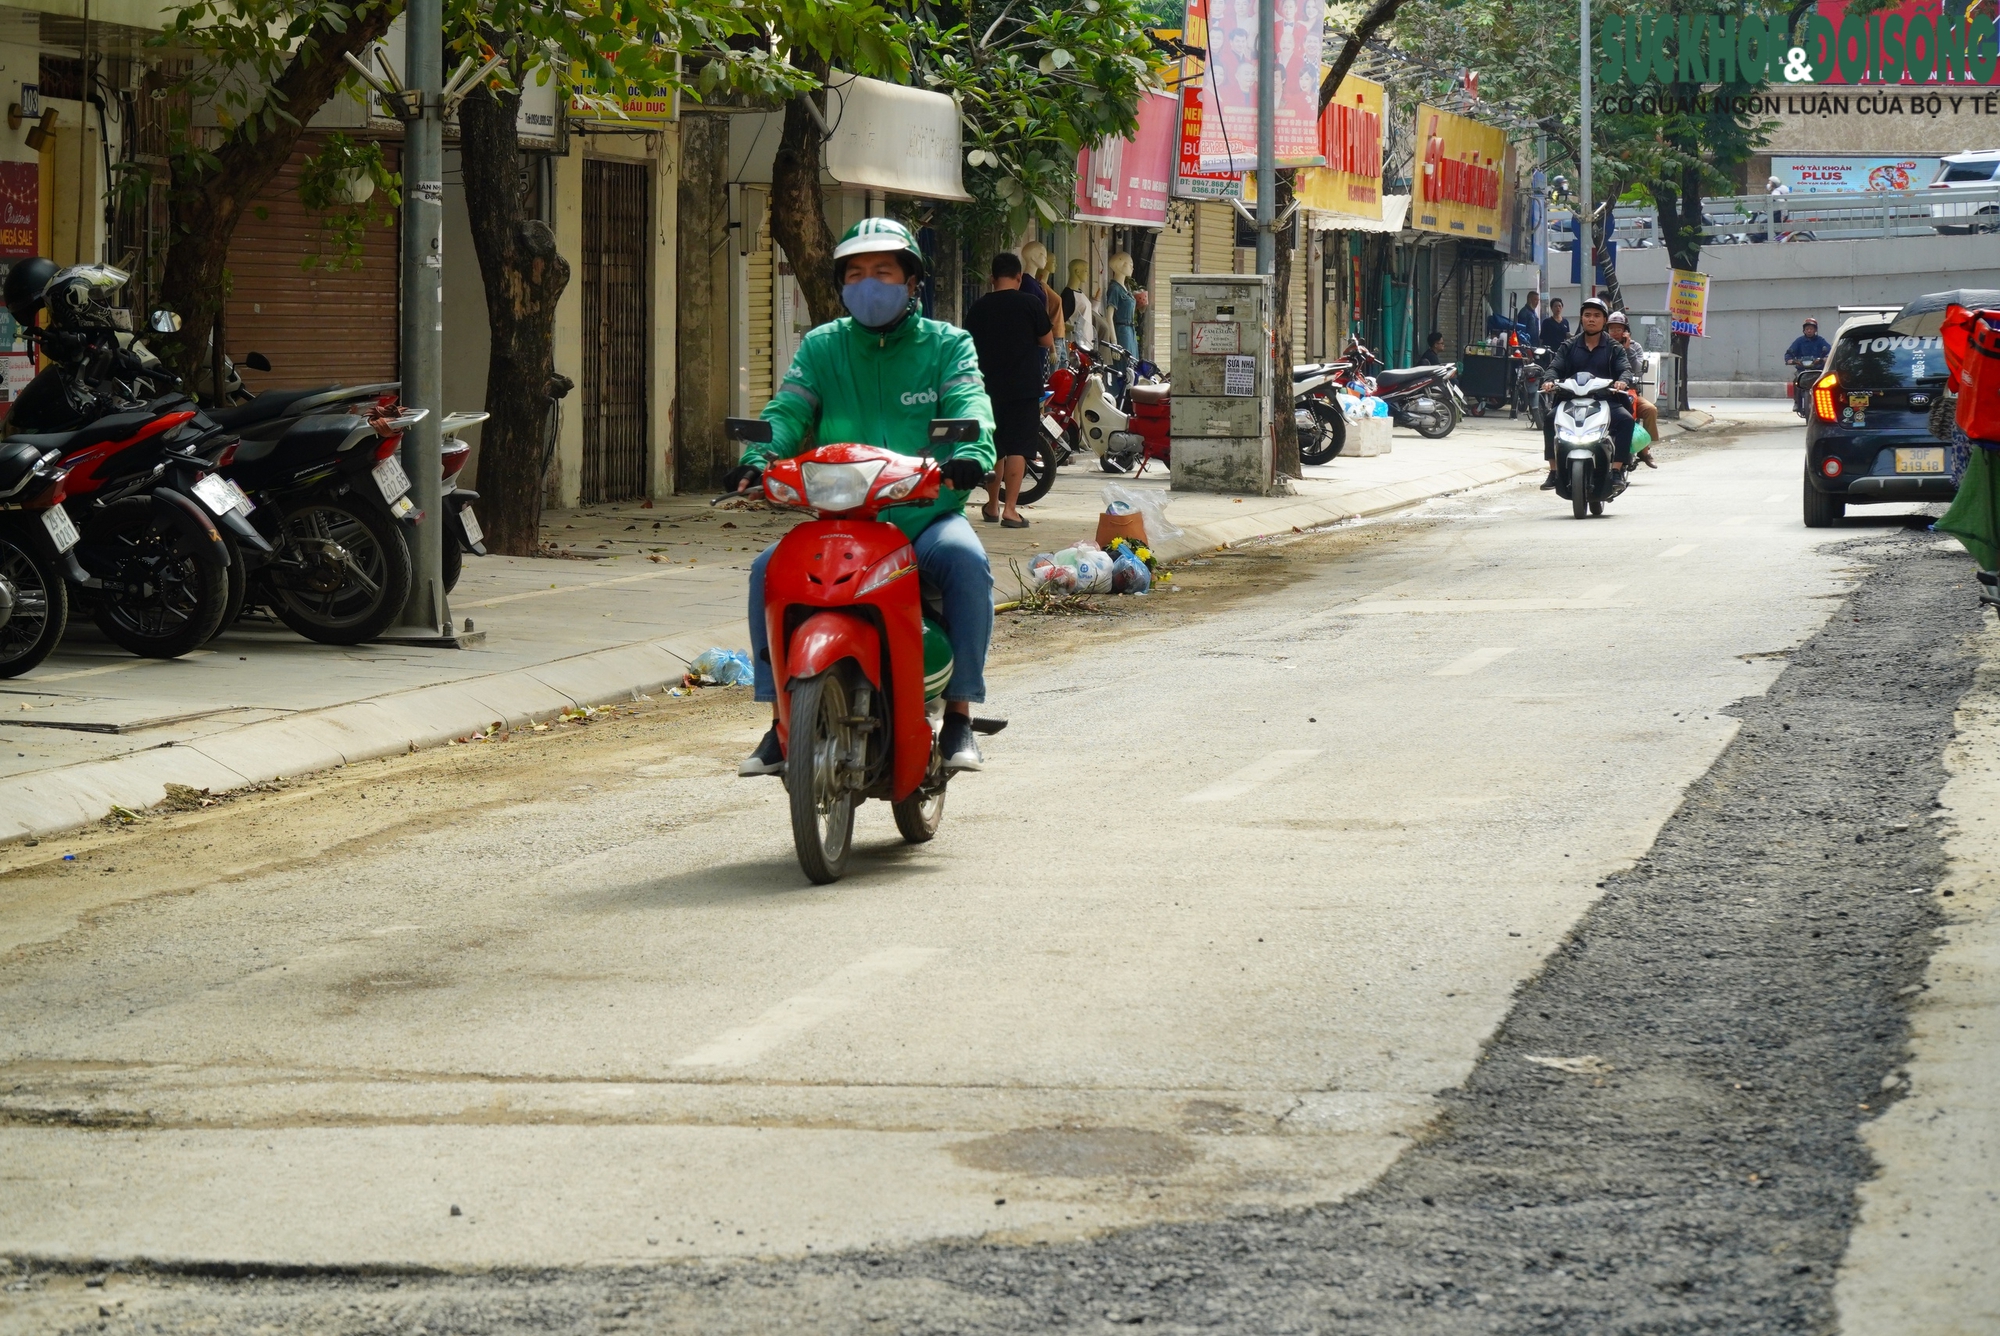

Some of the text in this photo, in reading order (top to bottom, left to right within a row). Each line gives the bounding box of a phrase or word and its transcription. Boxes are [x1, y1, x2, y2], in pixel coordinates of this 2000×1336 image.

[23, 89, 38, 112] 103
[645, 101, 666, 114] DỤC
[1802, 172, 1842, 181] PLUS
[18, 230, 33, 246] SALE
[900, 387, 939, 406] Grab
[1909, 449, 1931, 460] 30F
[1901, 460, 1939, 472] 319.18
[383, 472, 409, 500] 402.65
